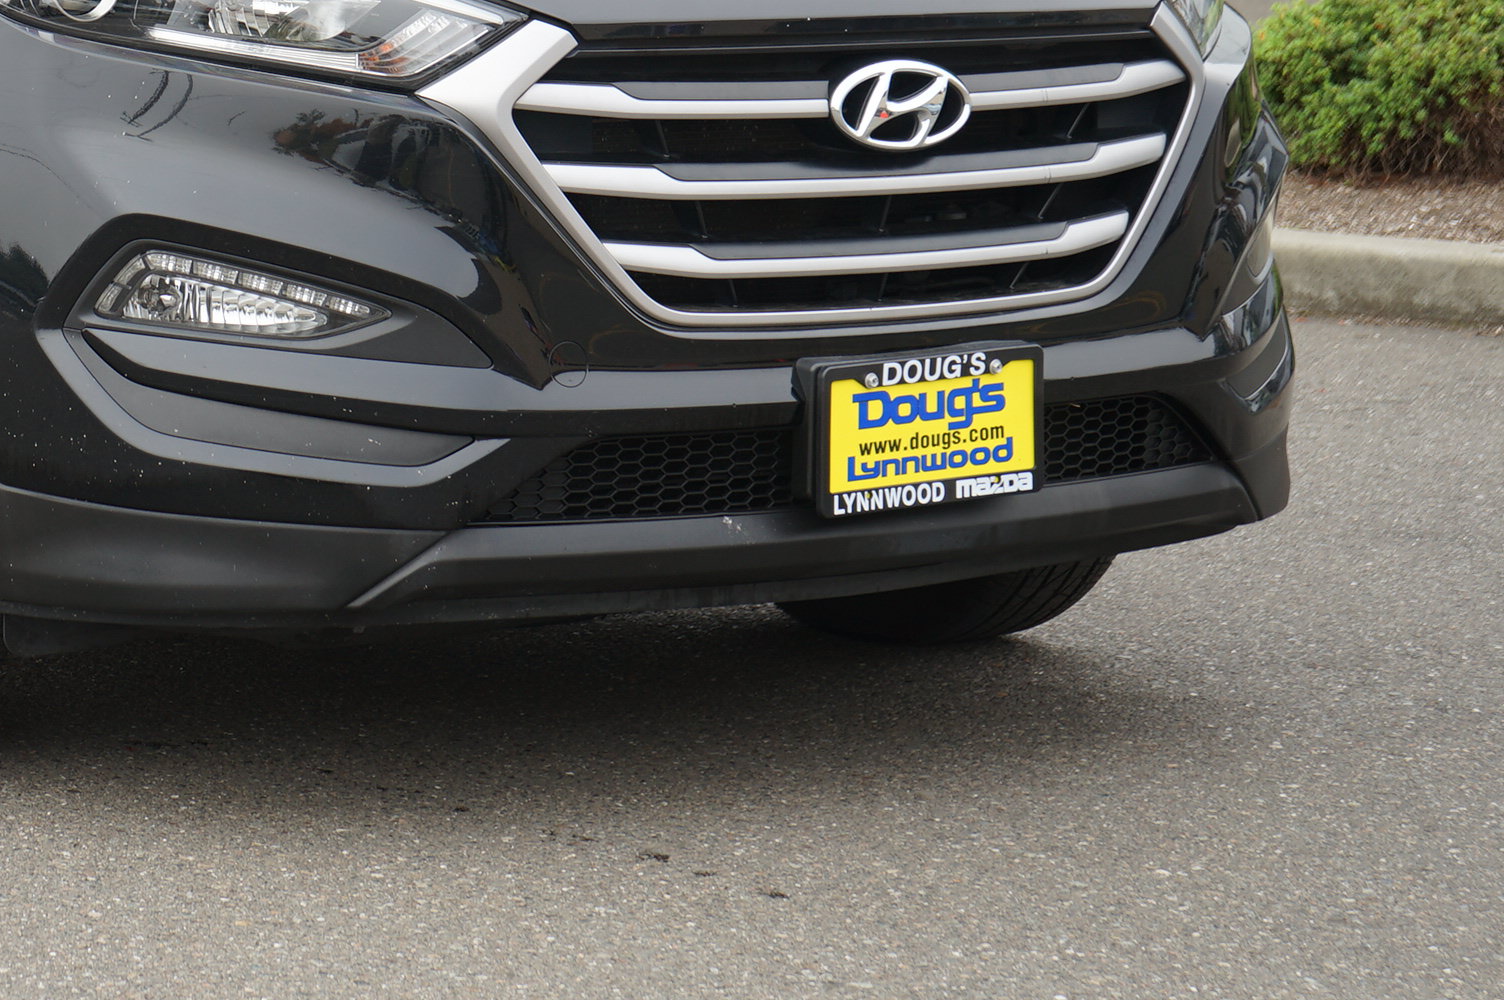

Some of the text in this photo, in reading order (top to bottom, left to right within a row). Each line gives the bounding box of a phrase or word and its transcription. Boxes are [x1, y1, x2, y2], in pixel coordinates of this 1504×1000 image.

[882, 352, 986, 386] DOUG'S
[859, 424, 1005, 456] www.dougs.com
[847, 436, 1014, 482] Lynnwood
[833, 481, 945, 516] LYNNWOOD
